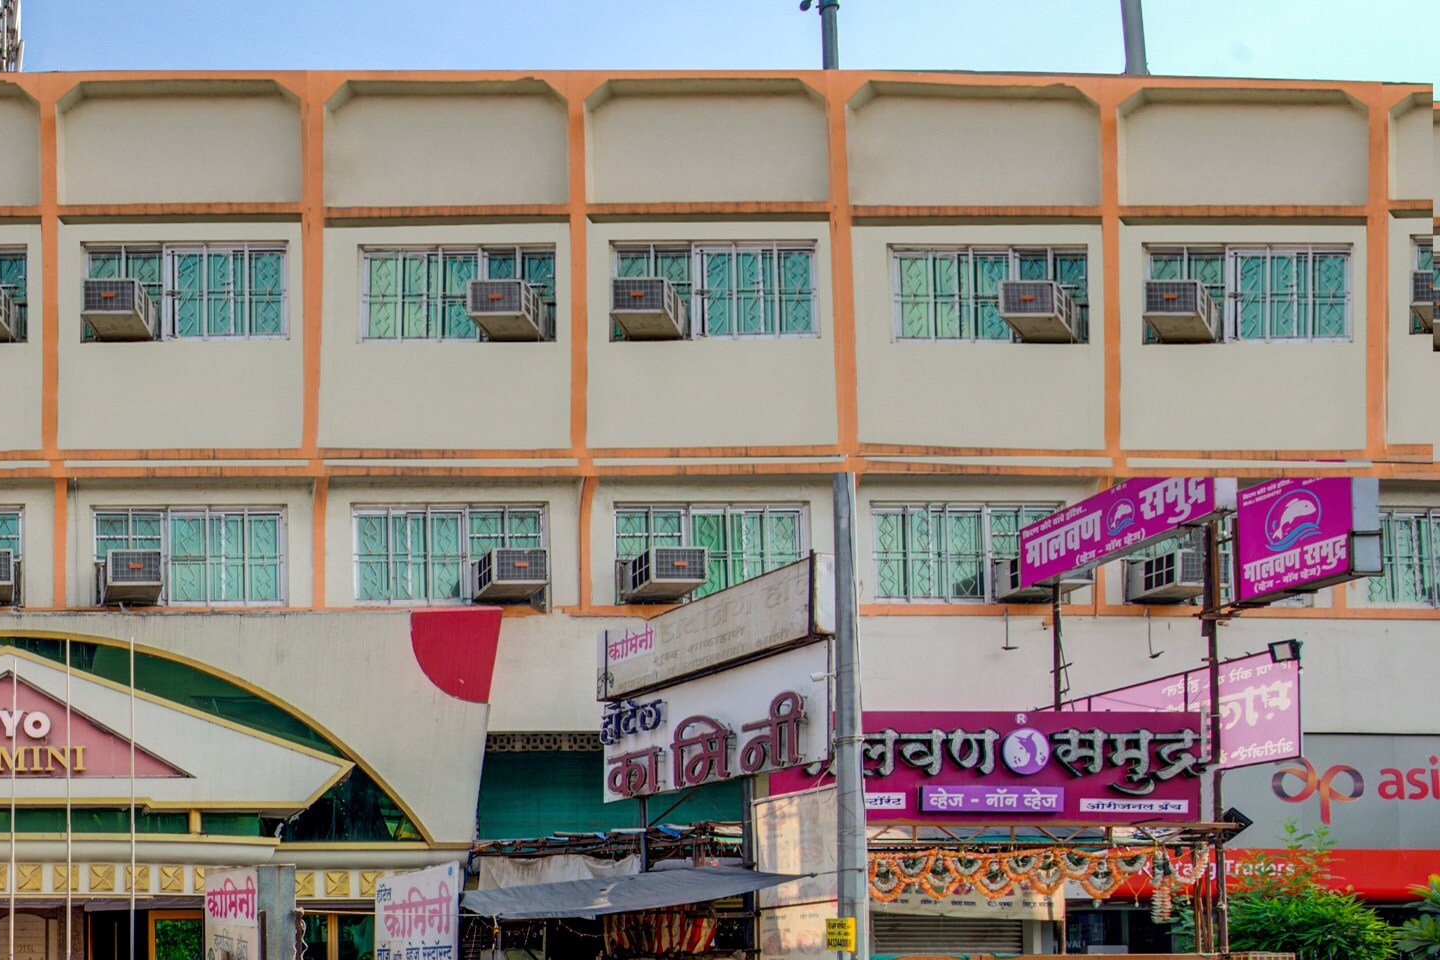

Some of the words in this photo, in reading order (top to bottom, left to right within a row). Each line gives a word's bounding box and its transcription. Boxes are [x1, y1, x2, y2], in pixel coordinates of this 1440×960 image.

[1025, 510, 1102, 568] मालवण
[1139, 476, 1206, 524] समुद्र
[1243, 547, 1301, 582] मालवण
[1303, 533, 1347, 570] समुद्र
[608, 623, 655, 660] कामिनी
[608, 690, 808, 797] कामिनी
[1049, 728, 1208, 796] समुद्र
[929, 788, 964, 810] व्हेज
[985, 788, 1018, 808] नॉन
[1024, 788, 1058, 810] व्हेज
[207, 875, 257, 921] कामिनी
[384, 881, 452, 938] कामिनी
